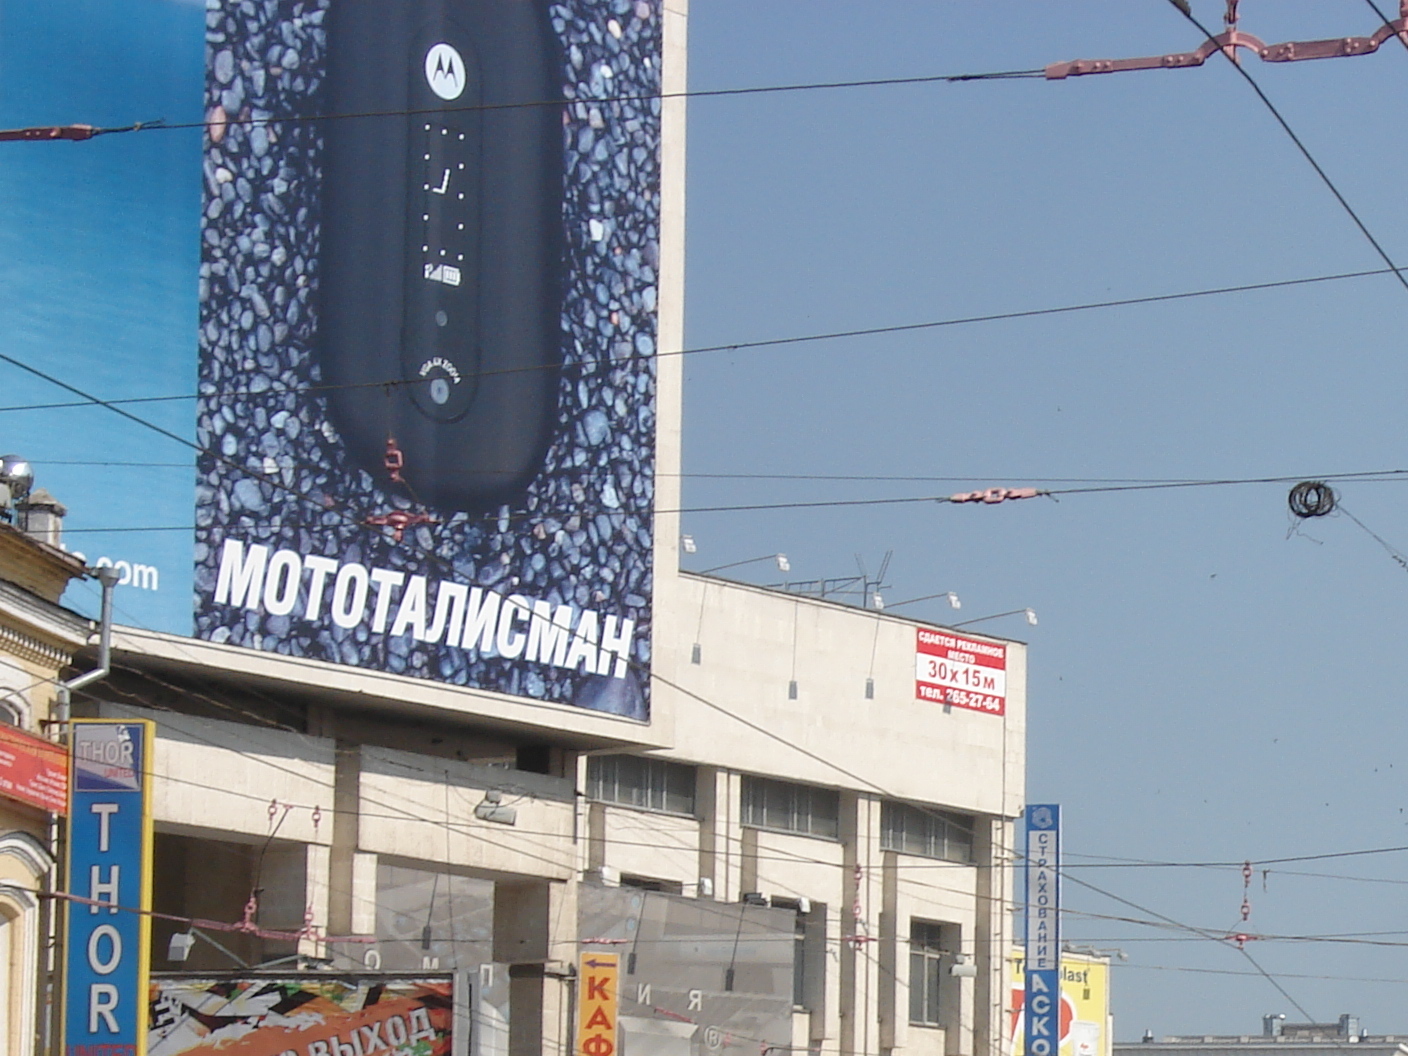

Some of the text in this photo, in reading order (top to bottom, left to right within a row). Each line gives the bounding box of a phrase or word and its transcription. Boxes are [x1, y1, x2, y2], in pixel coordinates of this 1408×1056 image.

[214, 539, 634, 679] МОТОТАЛИСМАН
[928, 660, 947, 680] 30
[963, 668, 981, 687] 15
[80, 741, 134, 764] THOR
[88, 803, 119, 1034] THOR
[1037, 833, 1048, 968] СТРАХОВАНИЕ
